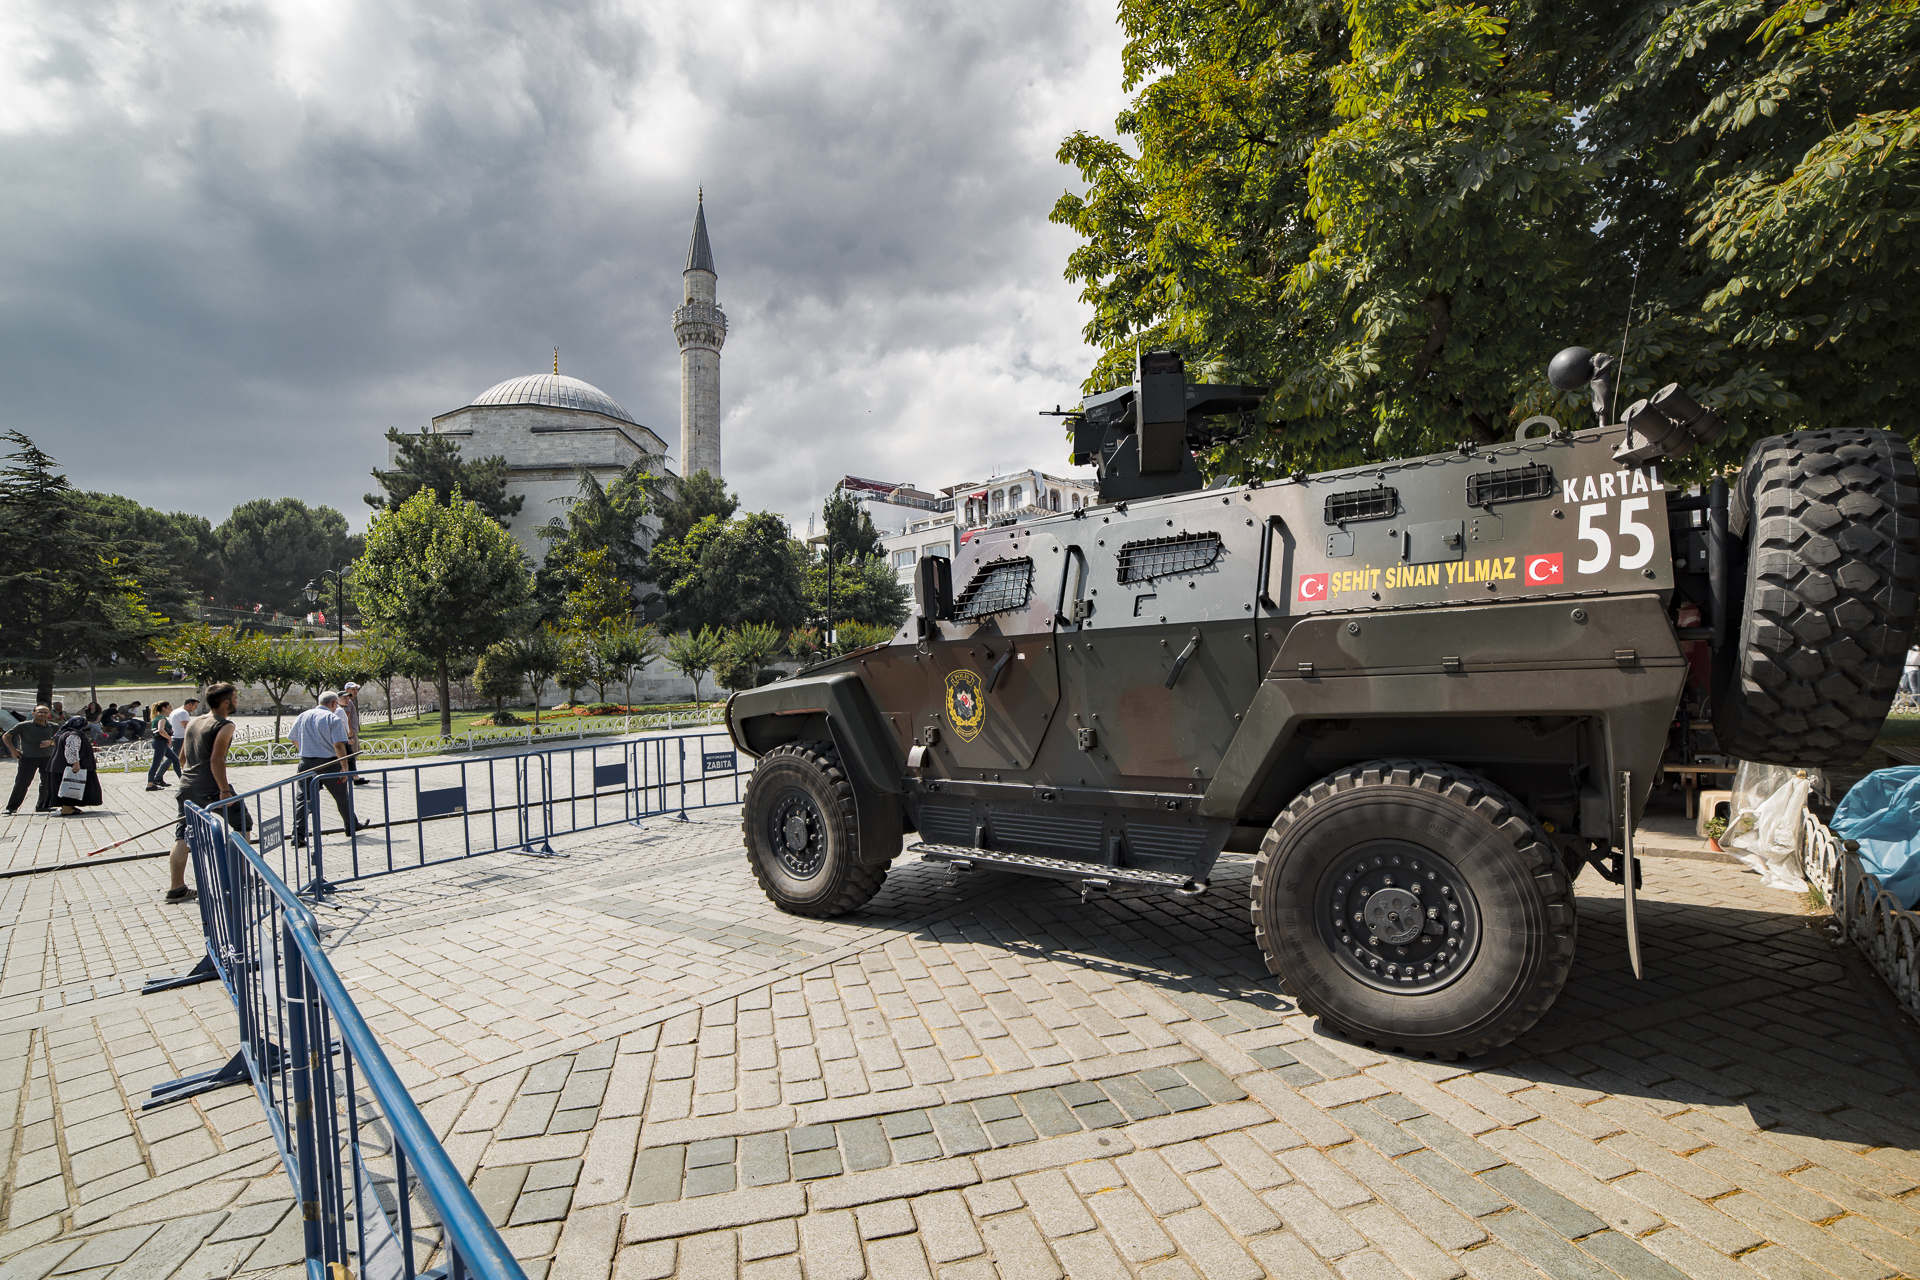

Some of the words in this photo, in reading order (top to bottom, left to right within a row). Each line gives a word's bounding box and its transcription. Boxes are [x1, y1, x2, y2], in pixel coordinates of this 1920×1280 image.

[1563, 466, 1664, 504] KARTAL
[1578, 497, 1655, 574] 55
[1331, 564, 1381, 597] ŞEHİT
[1385, 561, 1440, 588] SİNAN
[1445, 557, 1516, 584] YILMAZ
[707, 760, 732, 770] ZABITA
[263, 830, 282, 849] ZABITA
[1284, 910, 1331, 994] MICHELIN
